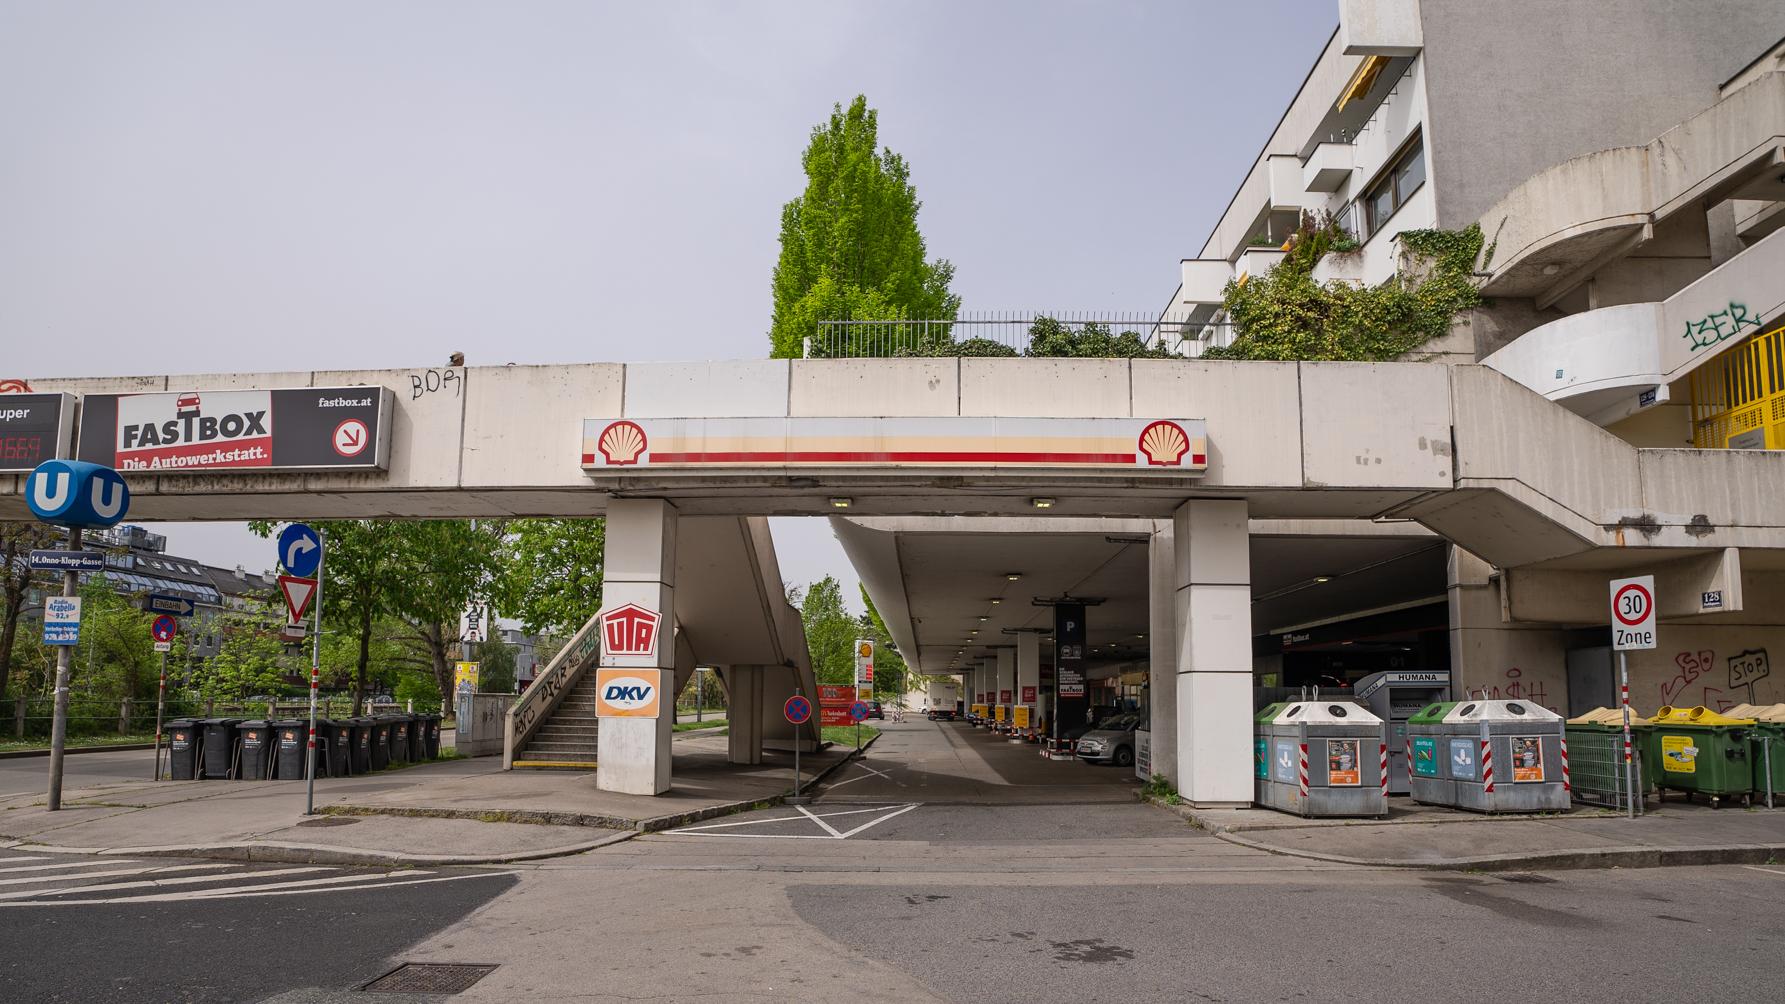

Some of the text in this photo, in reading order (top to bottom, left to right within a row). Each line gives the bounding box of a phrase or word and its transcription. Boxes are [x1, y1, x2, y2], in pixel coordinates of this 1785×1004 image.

[318, 397, 372, 408] fastbox.at
[123, 410, 267, 448] FASTBOX
[123, 446, 268, 469] Die Autowerkstatt.
[34, 472, 70, 511] U
[91, 476, 123, 519] U
[155, 600, 180, 610] EINBAHN
[1623, 595, 1642, 615] 30
[1704, 592, 1720, 602] 128
[49, 603, 76, 612] Arabella
[606, 608, 656, 651] UTA
[1066, 621, 1075, 631] P
[1617, 630, 1652, 646] Zone
[604, 686, 652, 700] DKV
